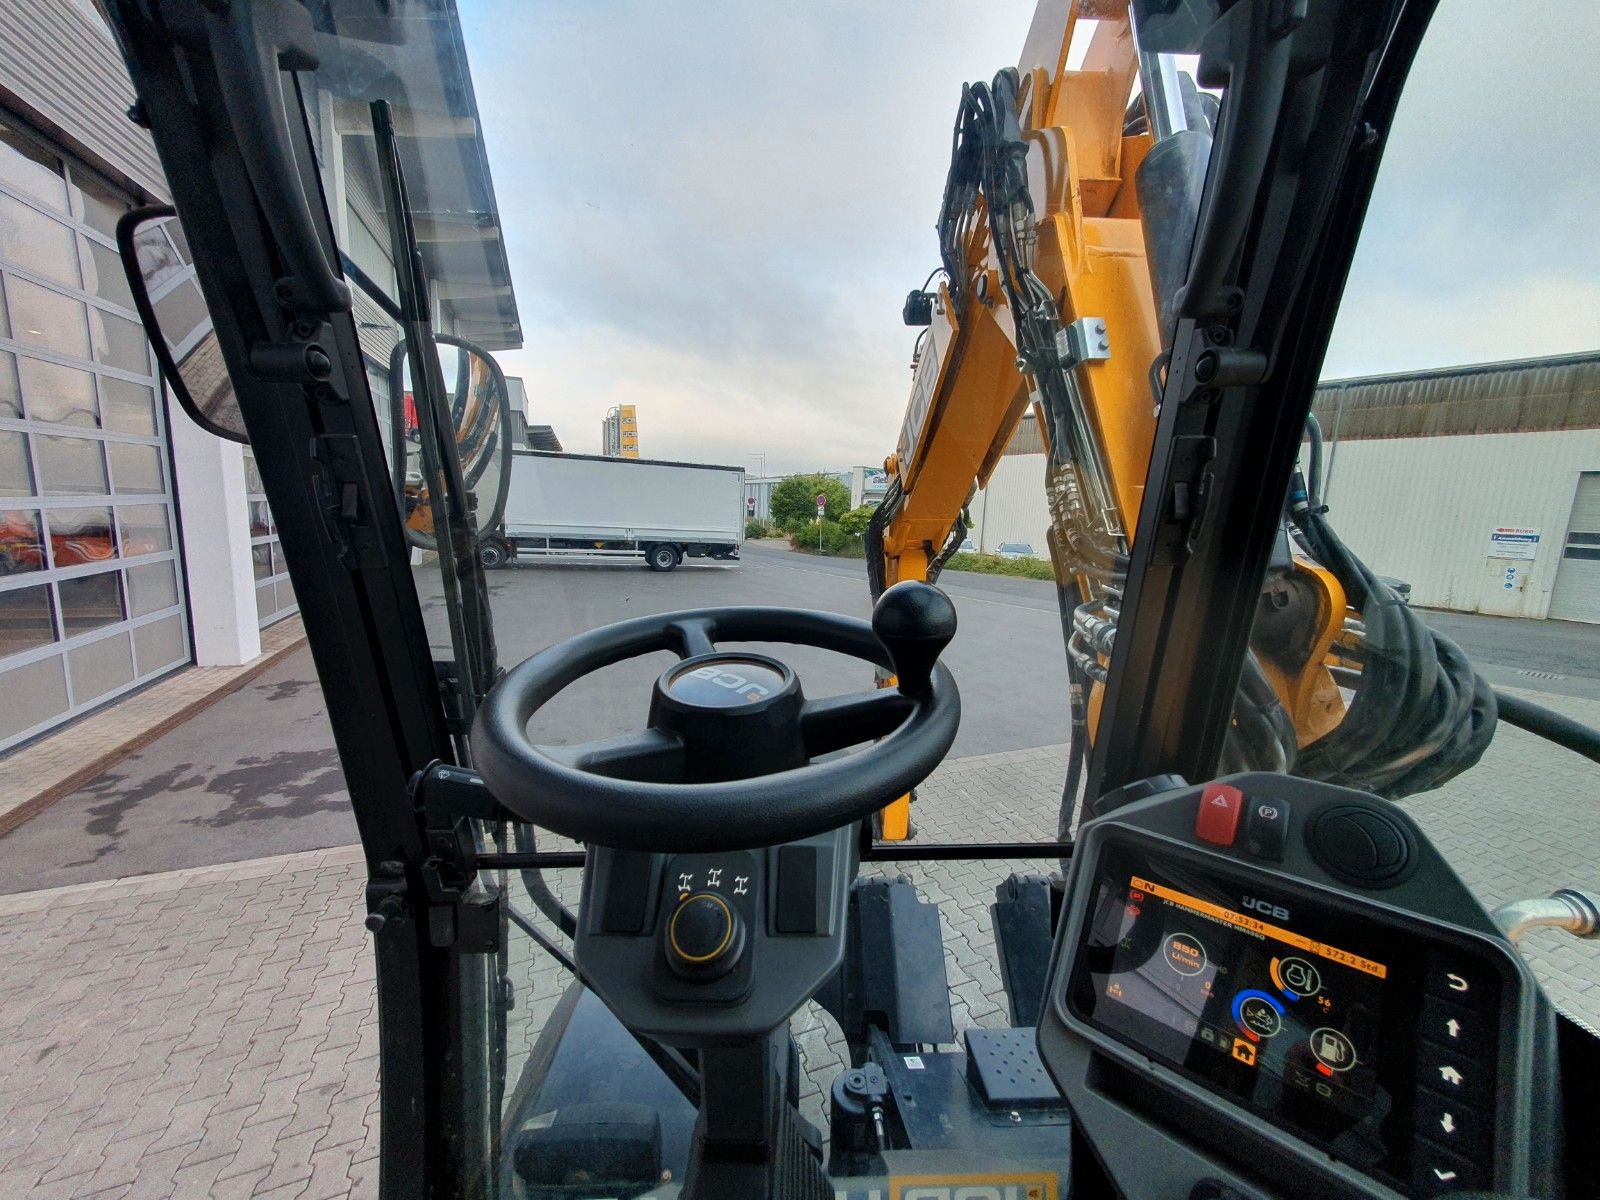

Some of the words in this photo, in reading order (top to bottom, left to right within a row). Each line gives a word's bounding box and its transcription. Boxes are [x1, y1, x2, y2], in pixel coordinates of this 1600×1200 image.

[687, 668, 768, 702] JCB
[1143, 882, 1156, 893] N
[1242, 895, 1290, 922] JCB
[1223, 909, 1265, 932] 07:53:34
[1325, 947, 1357, 966] 572.2
[1316, 995, 1332, 1008] 56
